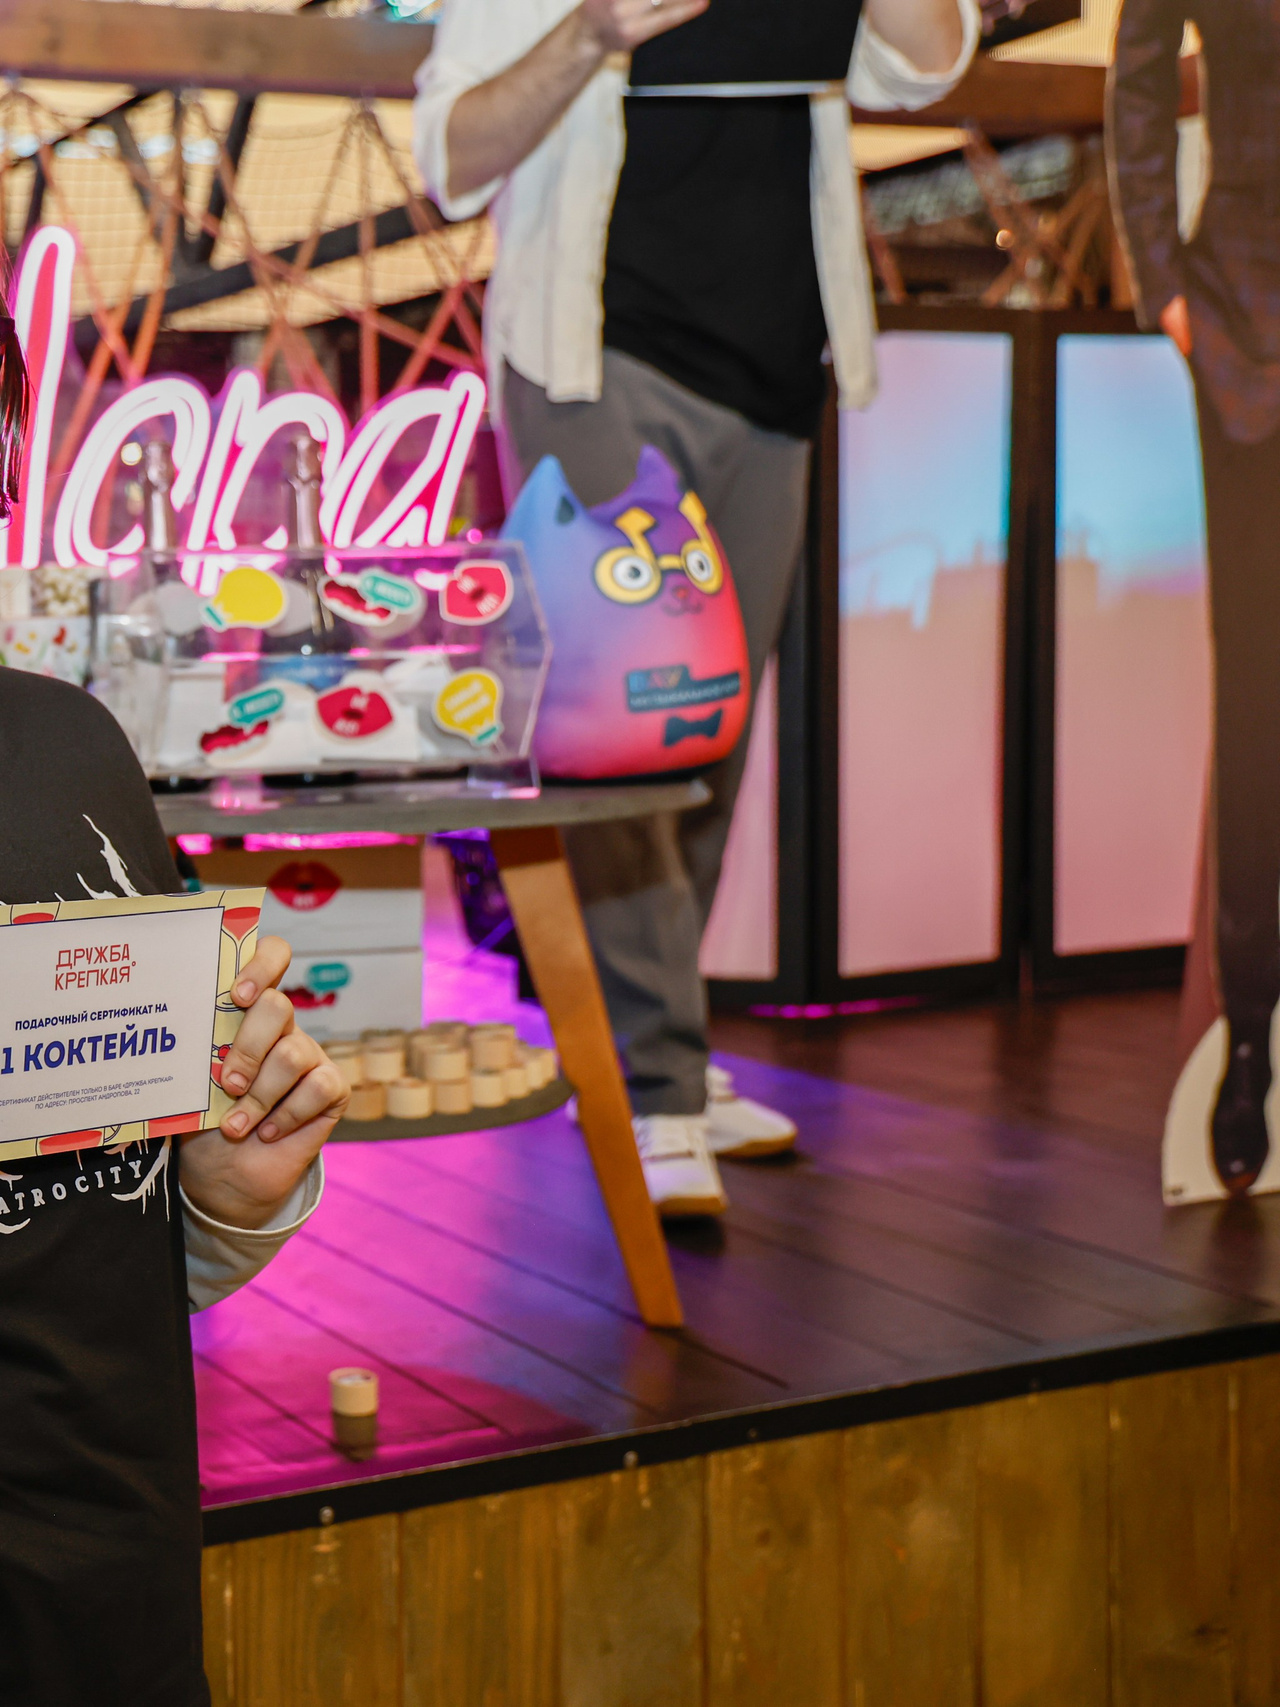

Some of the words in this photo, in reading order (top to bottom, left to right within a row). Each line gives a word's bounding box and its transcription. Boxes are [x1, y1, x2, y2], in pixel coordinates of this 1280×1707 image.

[56, 943, 130, 971] ДРУЖБА
[15, 1010, 88, 1031] ПОДАРОЧНЫЙ
[90, 1004, 154, 1022] СЕРТИФИКАТ
[155, 1003, 168, 1014] НА
[1, 1047, 15, 1075] 1
[23, 1023, 177, 1072] КОКТЕЙЛЬ
[35, 1102, 44, 1110] ПО
[68, 1095, 97, 1105] ПРОСПЕКТ
[134, 1087, 141, 1095] 22
[37, 1089, 80, 1103] ДЕЙСТВИТЕЛЕН
[81, 1085, 103, 1095] ТОЛЬКО
[108, 1083, 122, 1092] БАРЕ
